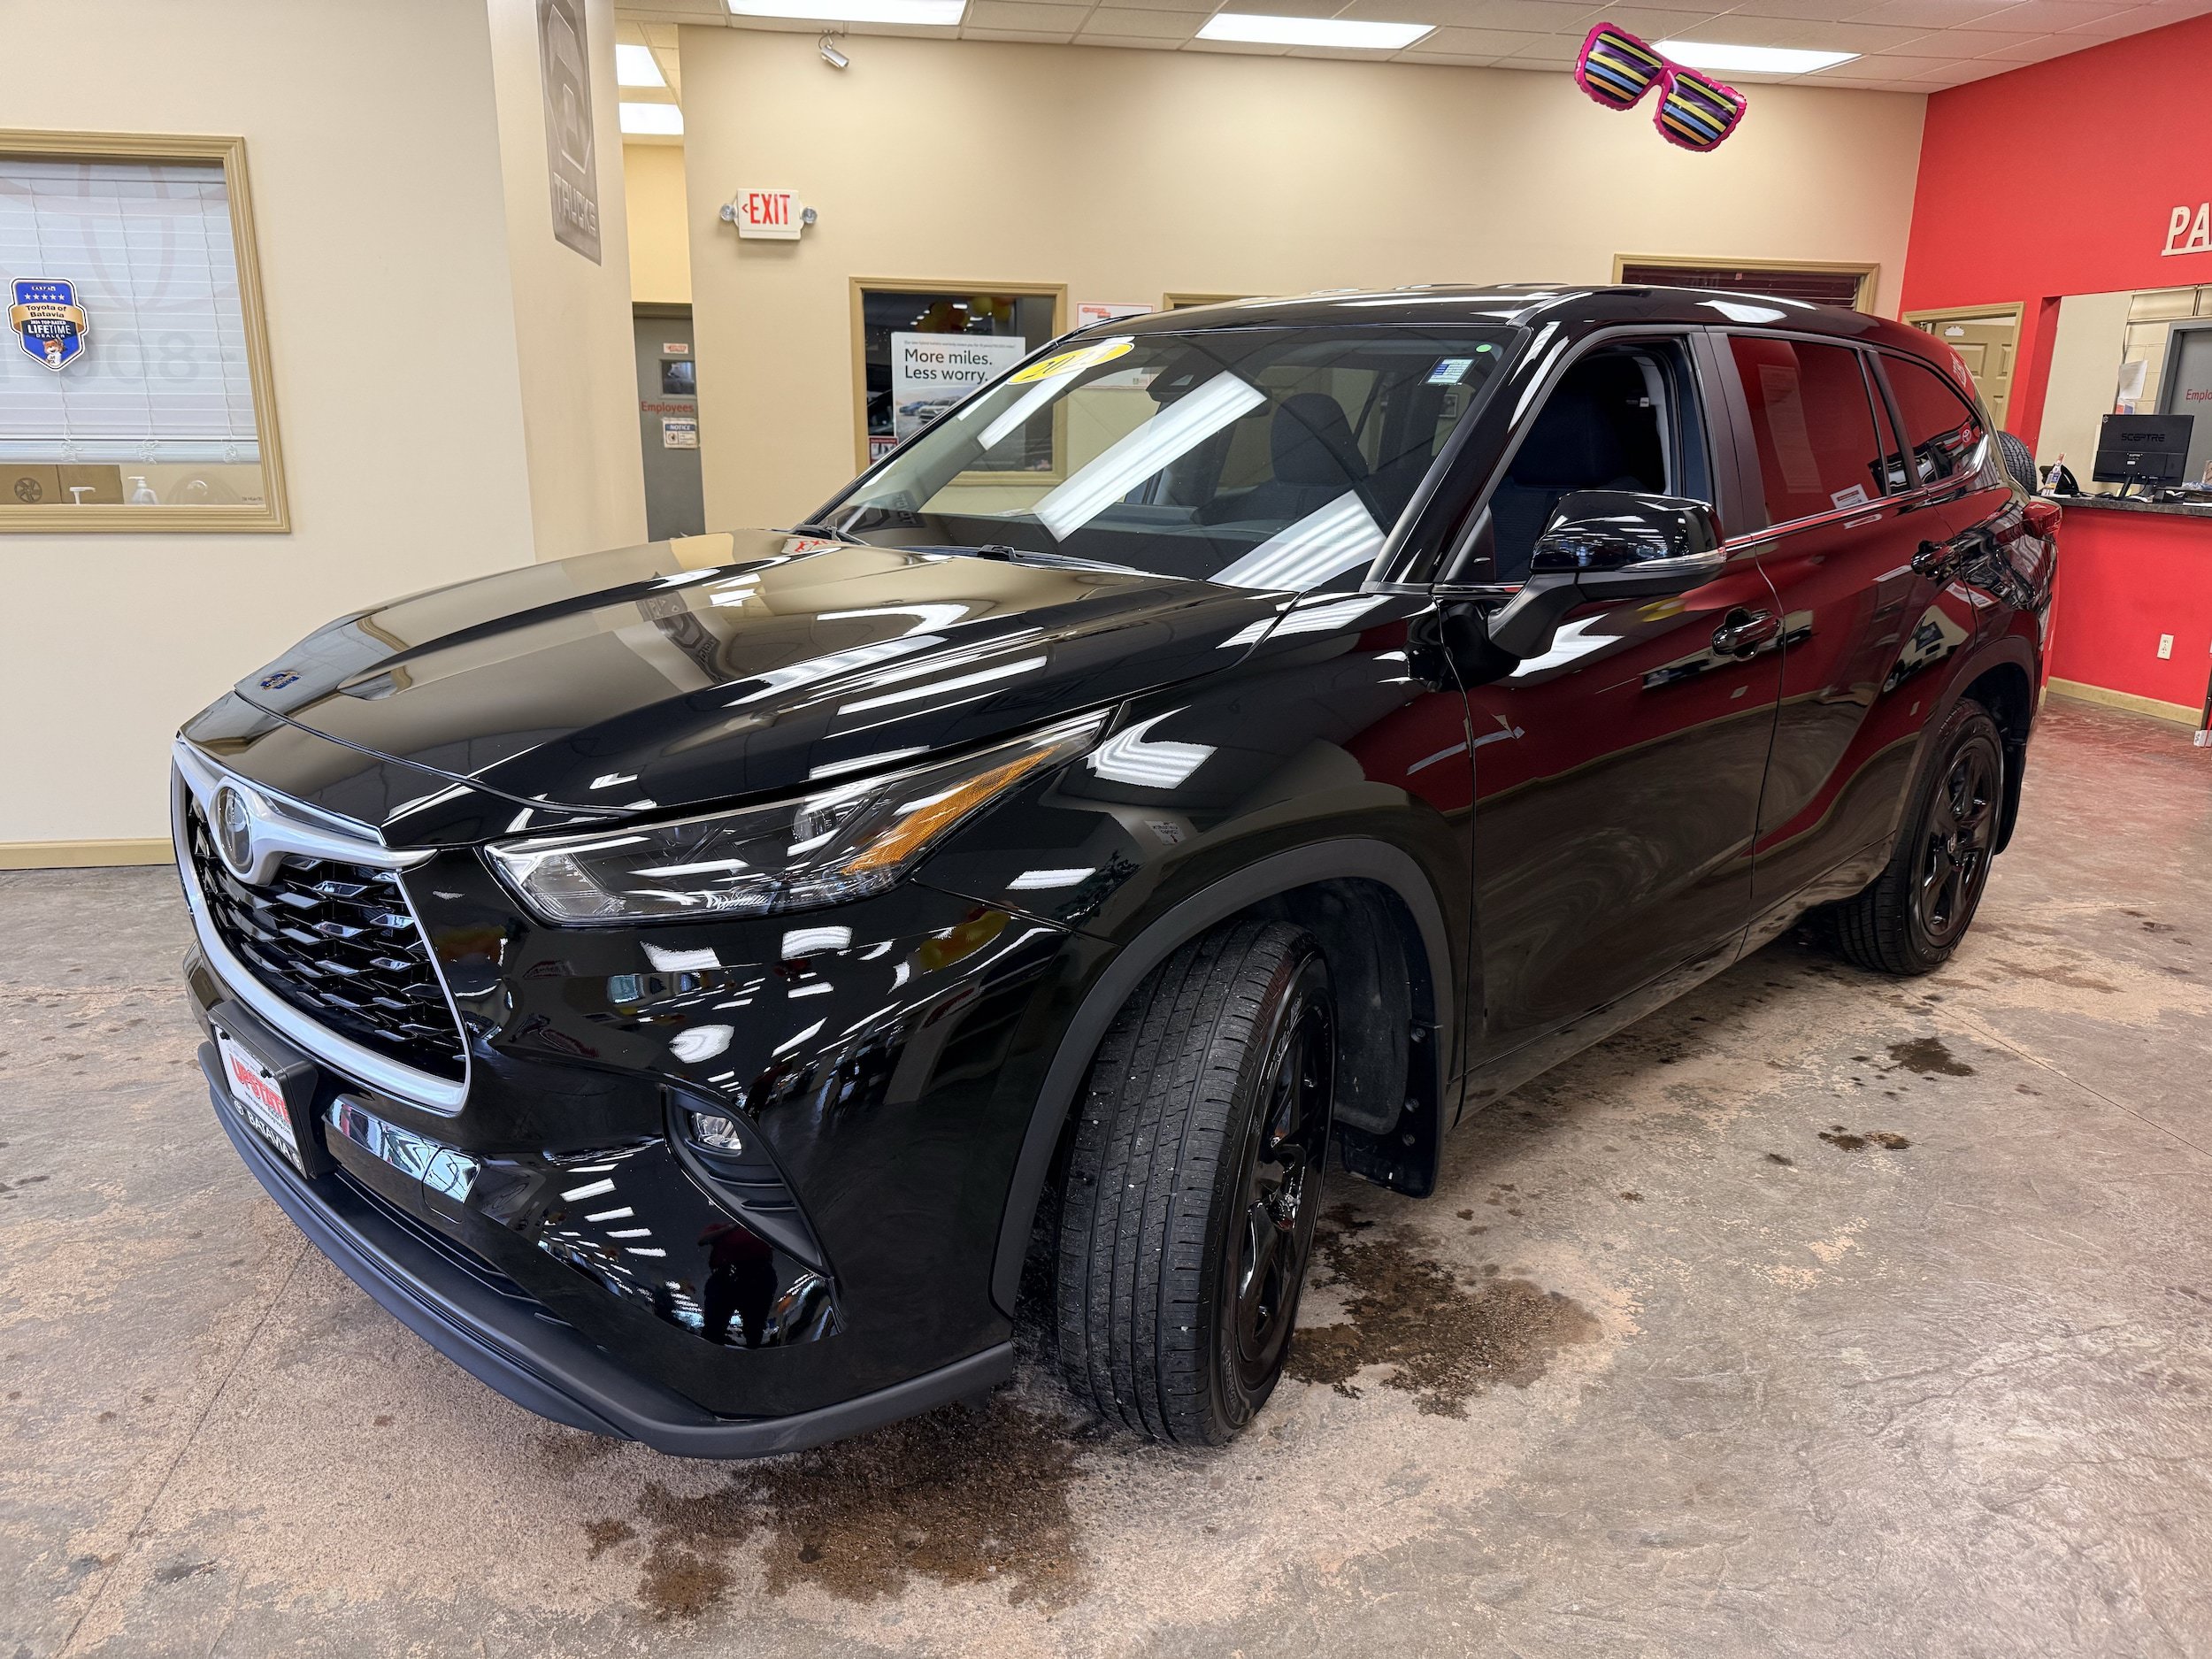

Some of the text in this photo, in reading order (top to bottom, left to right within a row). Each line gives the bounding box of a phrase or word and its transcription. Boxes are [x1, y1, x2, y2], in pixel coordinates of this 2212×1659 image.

[749, 193, 790, 225] EXIT
[27, 325, 71, 334] LIFETIME
[904, 349, 993, 365] More miles.
[905, 365, 988, 385] Less worry.
[641, 401, 695, 414] Employees
[2121, 433, 2166, 442] SCEPTRE
[247, 1110, 292, 1161] BATAVIA
